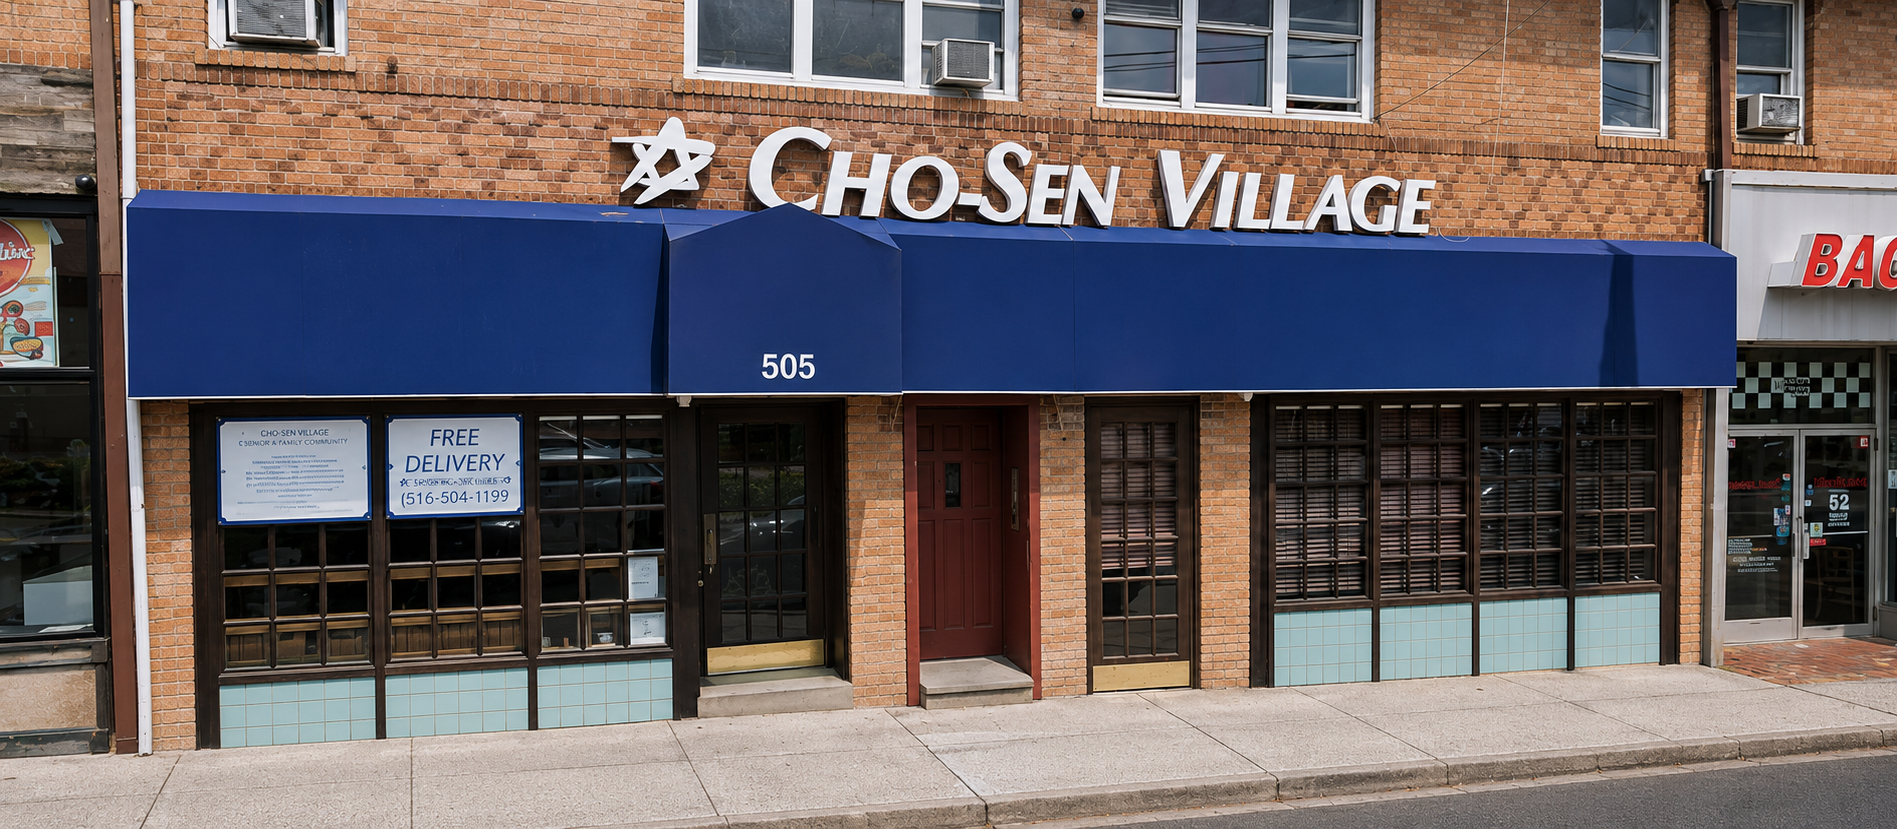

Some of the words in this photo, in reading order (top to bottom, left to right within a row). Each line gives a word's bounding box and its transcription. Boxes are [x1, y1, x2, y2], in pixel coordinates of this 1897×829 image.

[748, 126, 1121, 227] CHO-SEN
[1157, 150, 1437, 234] VILLAGE
[761, 353, 816, 380] 505
[260, 429, 296, 437] CHO-SEN
[298, 428, 329, 437] VILLAGE
[430, 428, 480, 447] FREE
[405, 453, 506, 473] DELIVERY
[401, 489, 509, 508] (516-504-1199
[1829, 494, 1850, 511] 52
